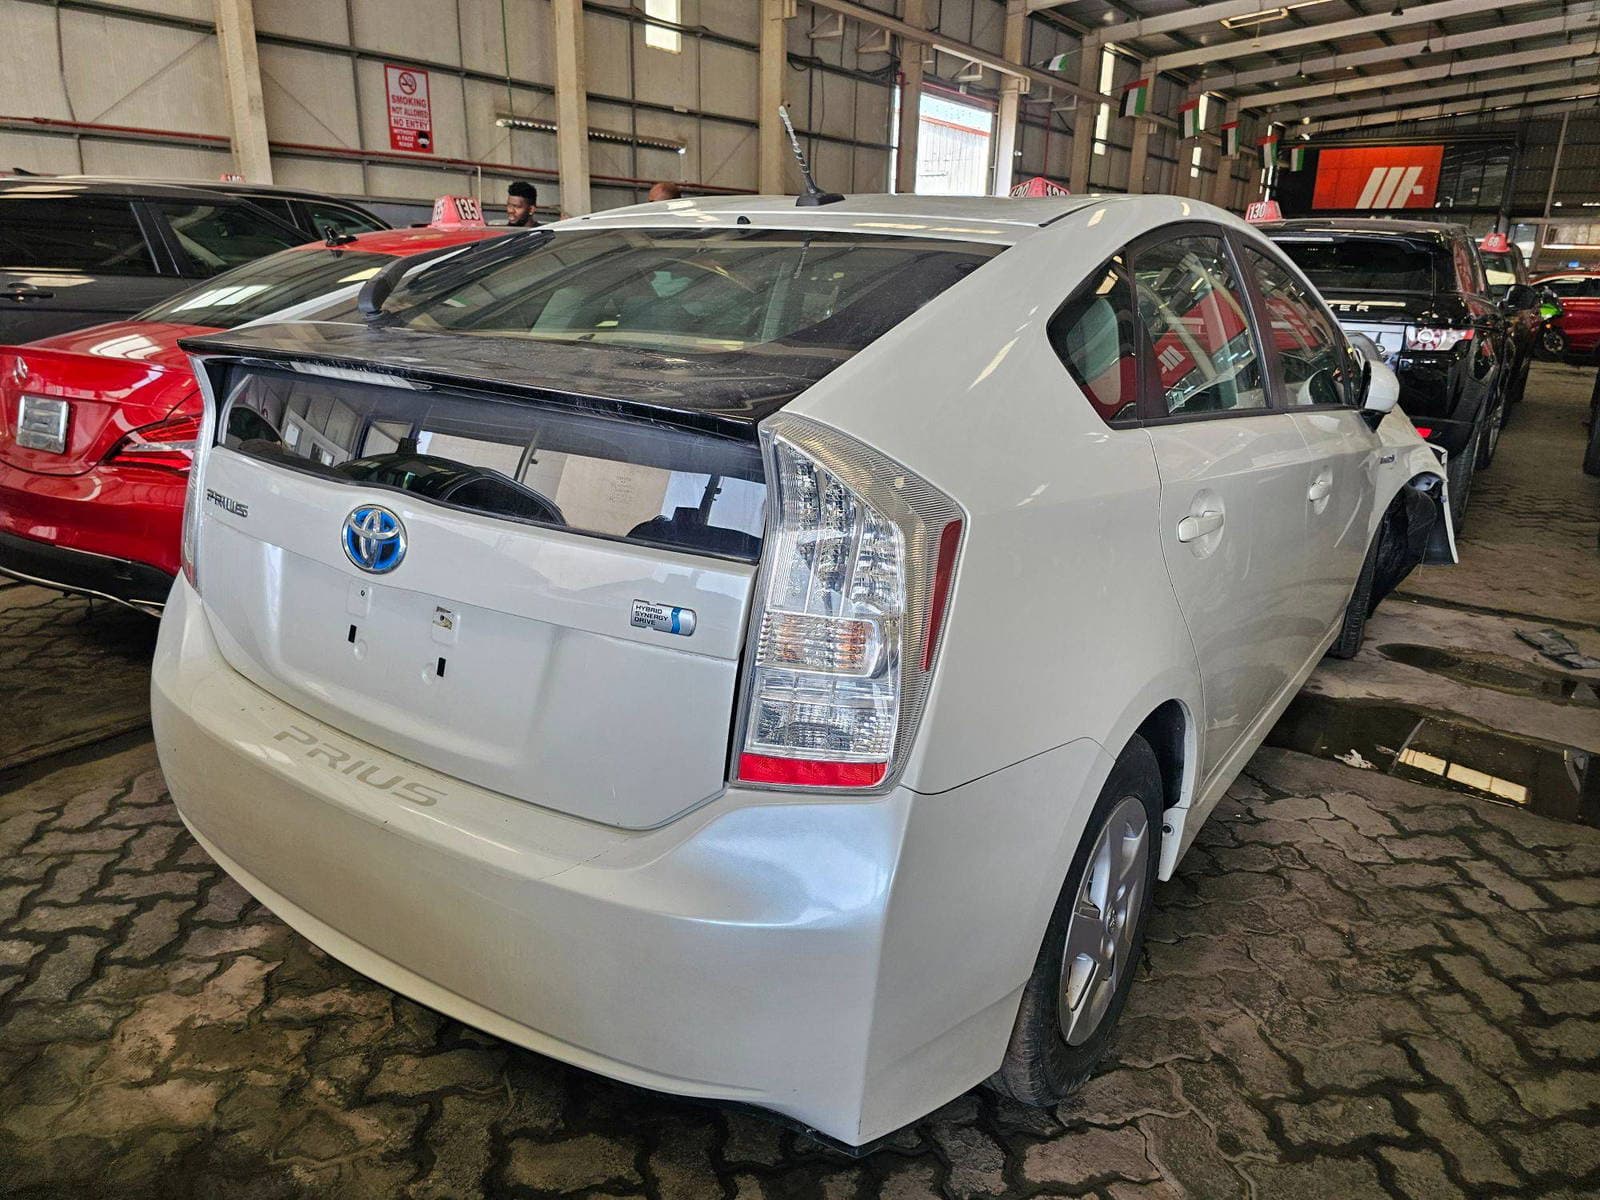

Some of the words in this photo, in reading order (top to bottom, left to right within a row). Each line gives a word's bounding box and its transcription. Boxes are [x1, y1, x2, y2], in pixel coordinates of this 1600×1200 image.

[391, 95, 427, 108] SMOKING
[391, 107, 403, 115] NOT
[404, 109, 429, 118] ALLOWED
[393, 118, 404, 127] NO
[406, 119, 428, 130] ENTRY
[455, 198, 480, 220] 135
[1250, 202, 1266, 219] 130
[206, 488, 249, 518] PRIUS
[635, 605, 663, 614] HYBRID
[634, 617, 656, 626] DRIVE
[635, 611, 668, 621] SYNERGY
[272, 724, 449, 807] PRIUS
